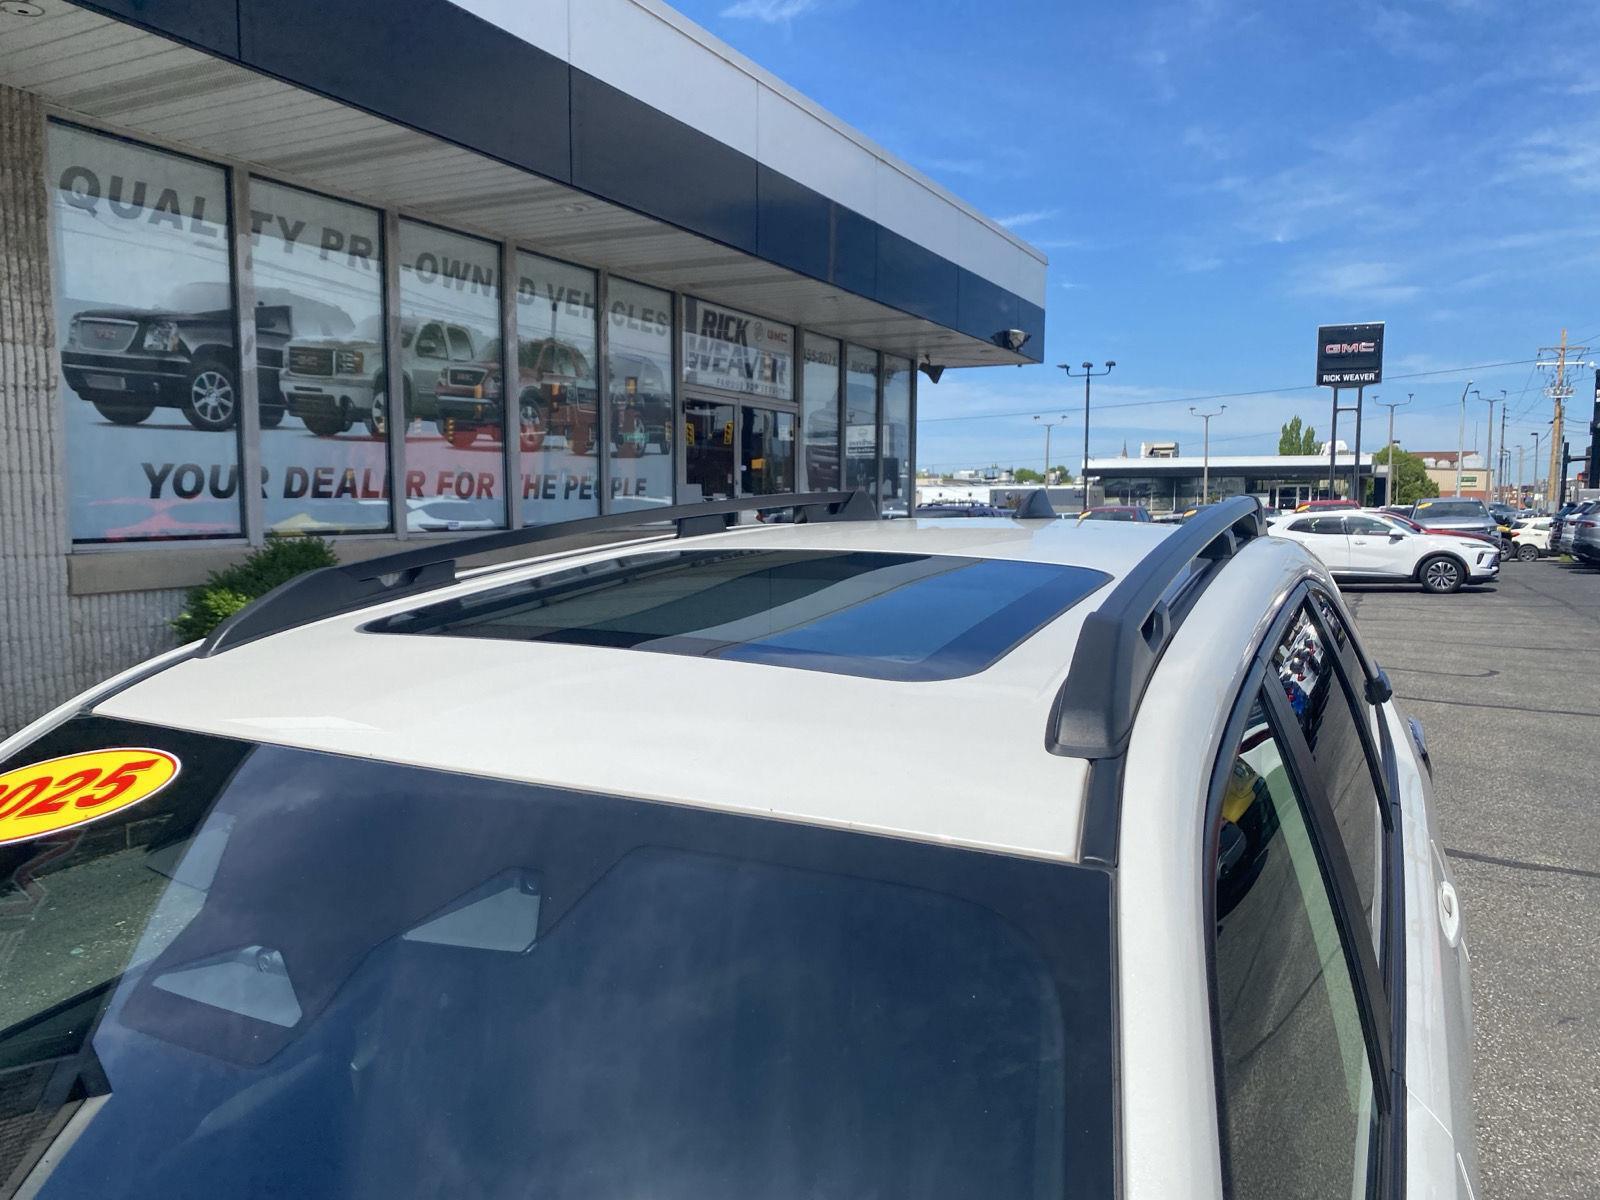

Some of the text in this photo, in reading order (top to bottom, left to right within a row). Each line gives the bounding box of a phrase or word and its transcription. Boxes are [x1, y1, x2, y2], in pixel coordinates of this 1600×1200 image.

[59, 166, 668, 337] QUALTY PR-OWND VEHCLES
[701, 308, 750, 347] RICK
[1325, 342, 1375, 354] GMC
[1322, 373, 1375, 382] RICK WEAVER
[436, 470, 495, 500] FOR
[520, 473, 557, 499] HE
[0, 758, 160, 821] 025
